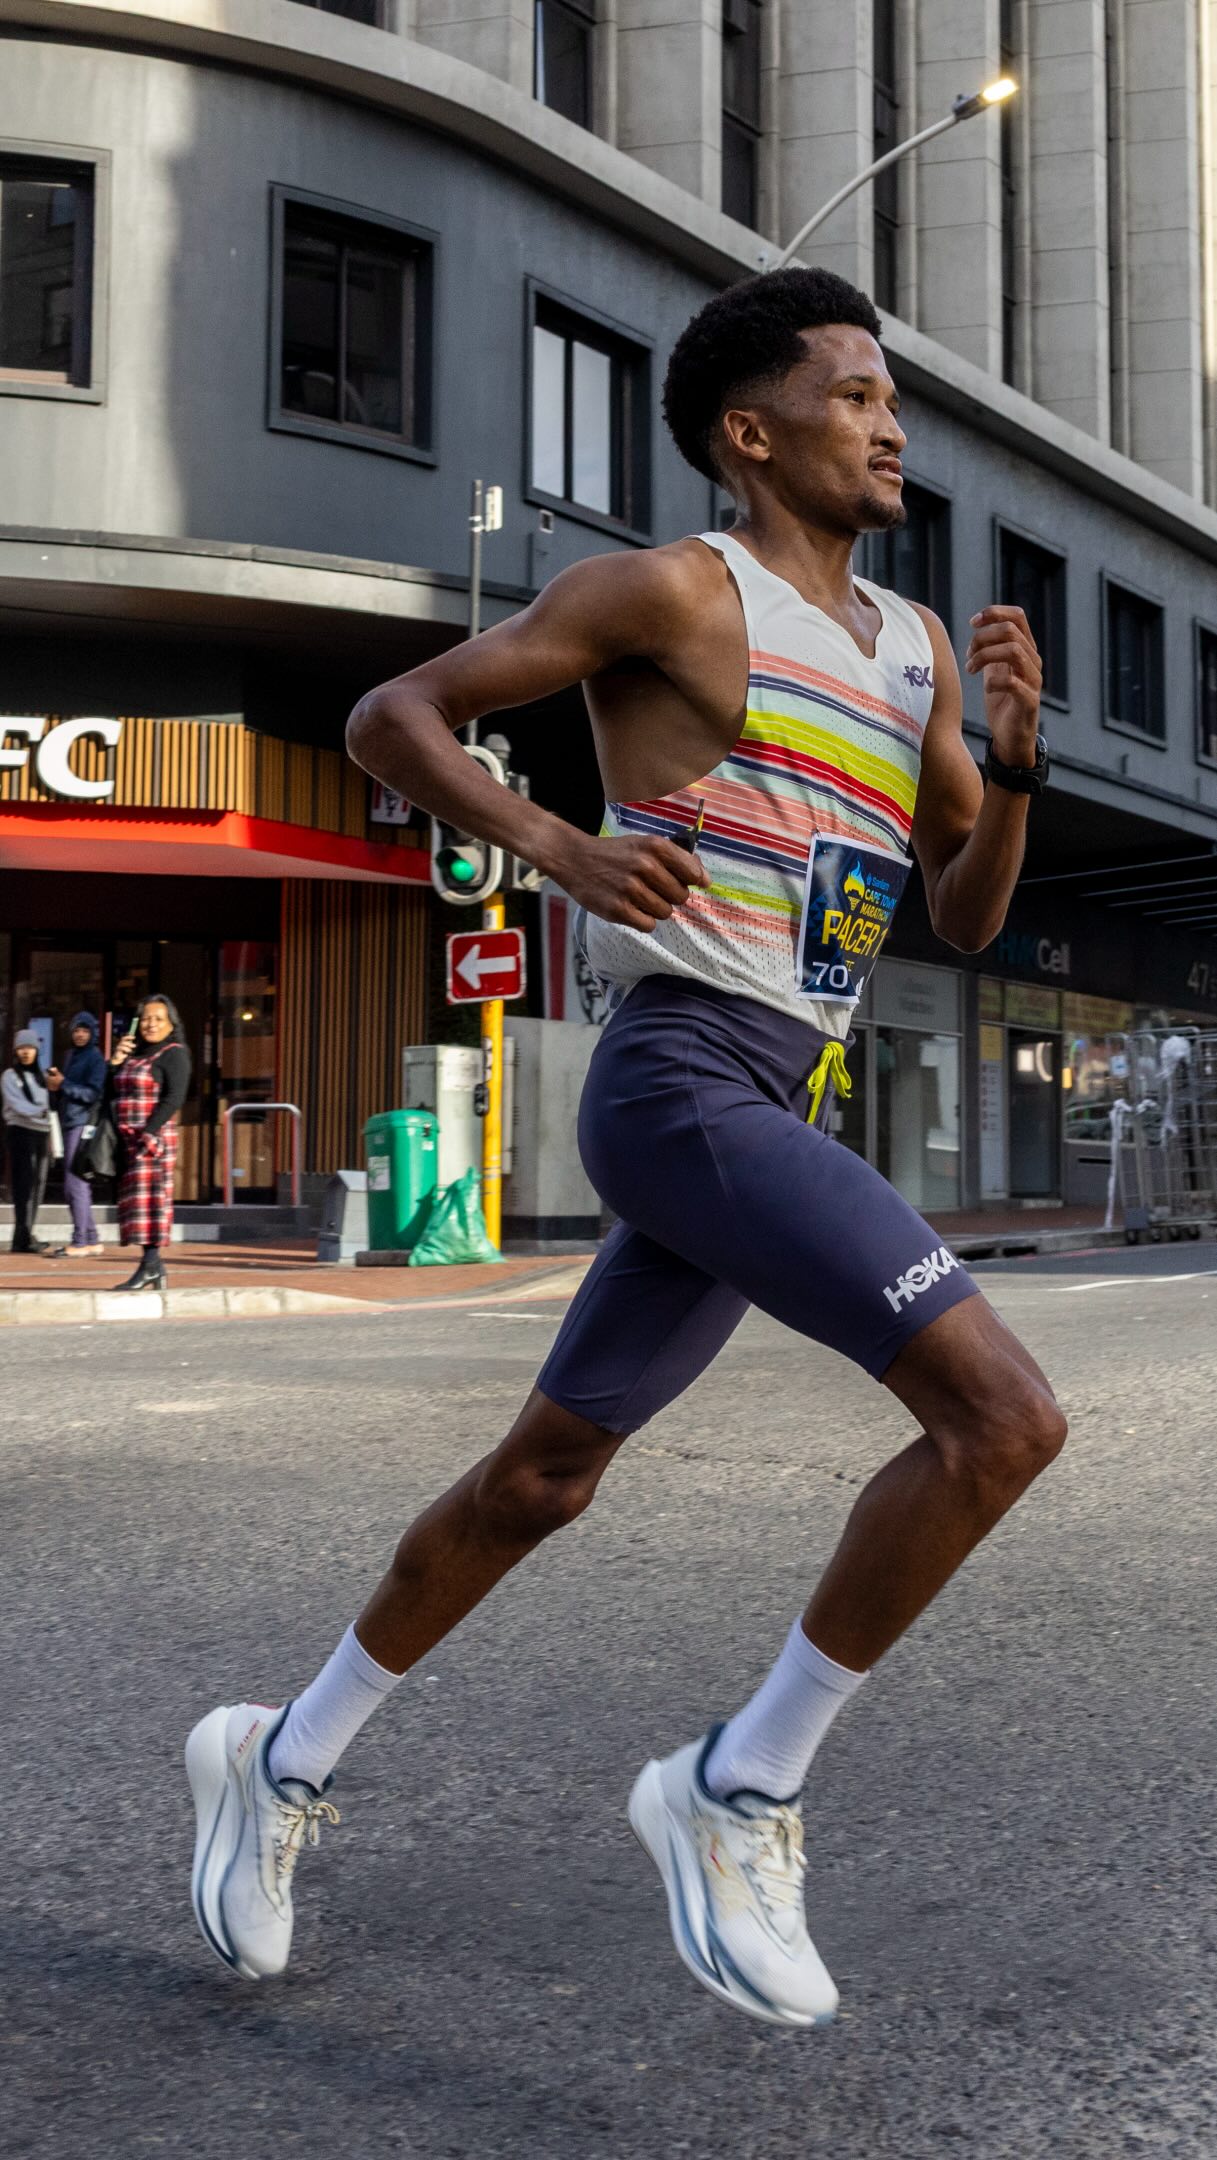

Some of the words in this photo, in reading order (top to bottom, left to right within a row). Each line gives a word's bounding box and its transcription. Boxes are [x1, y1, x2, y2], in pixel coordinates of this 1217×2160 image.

[860, 902, 891, 922] MARATHON
[864, 888, 882, 905] CAPE
[880, 894, 897, 910] TOWN
[822, 909, 880, 957] PACER
[882, 1246, 960, 1314] HOKA
